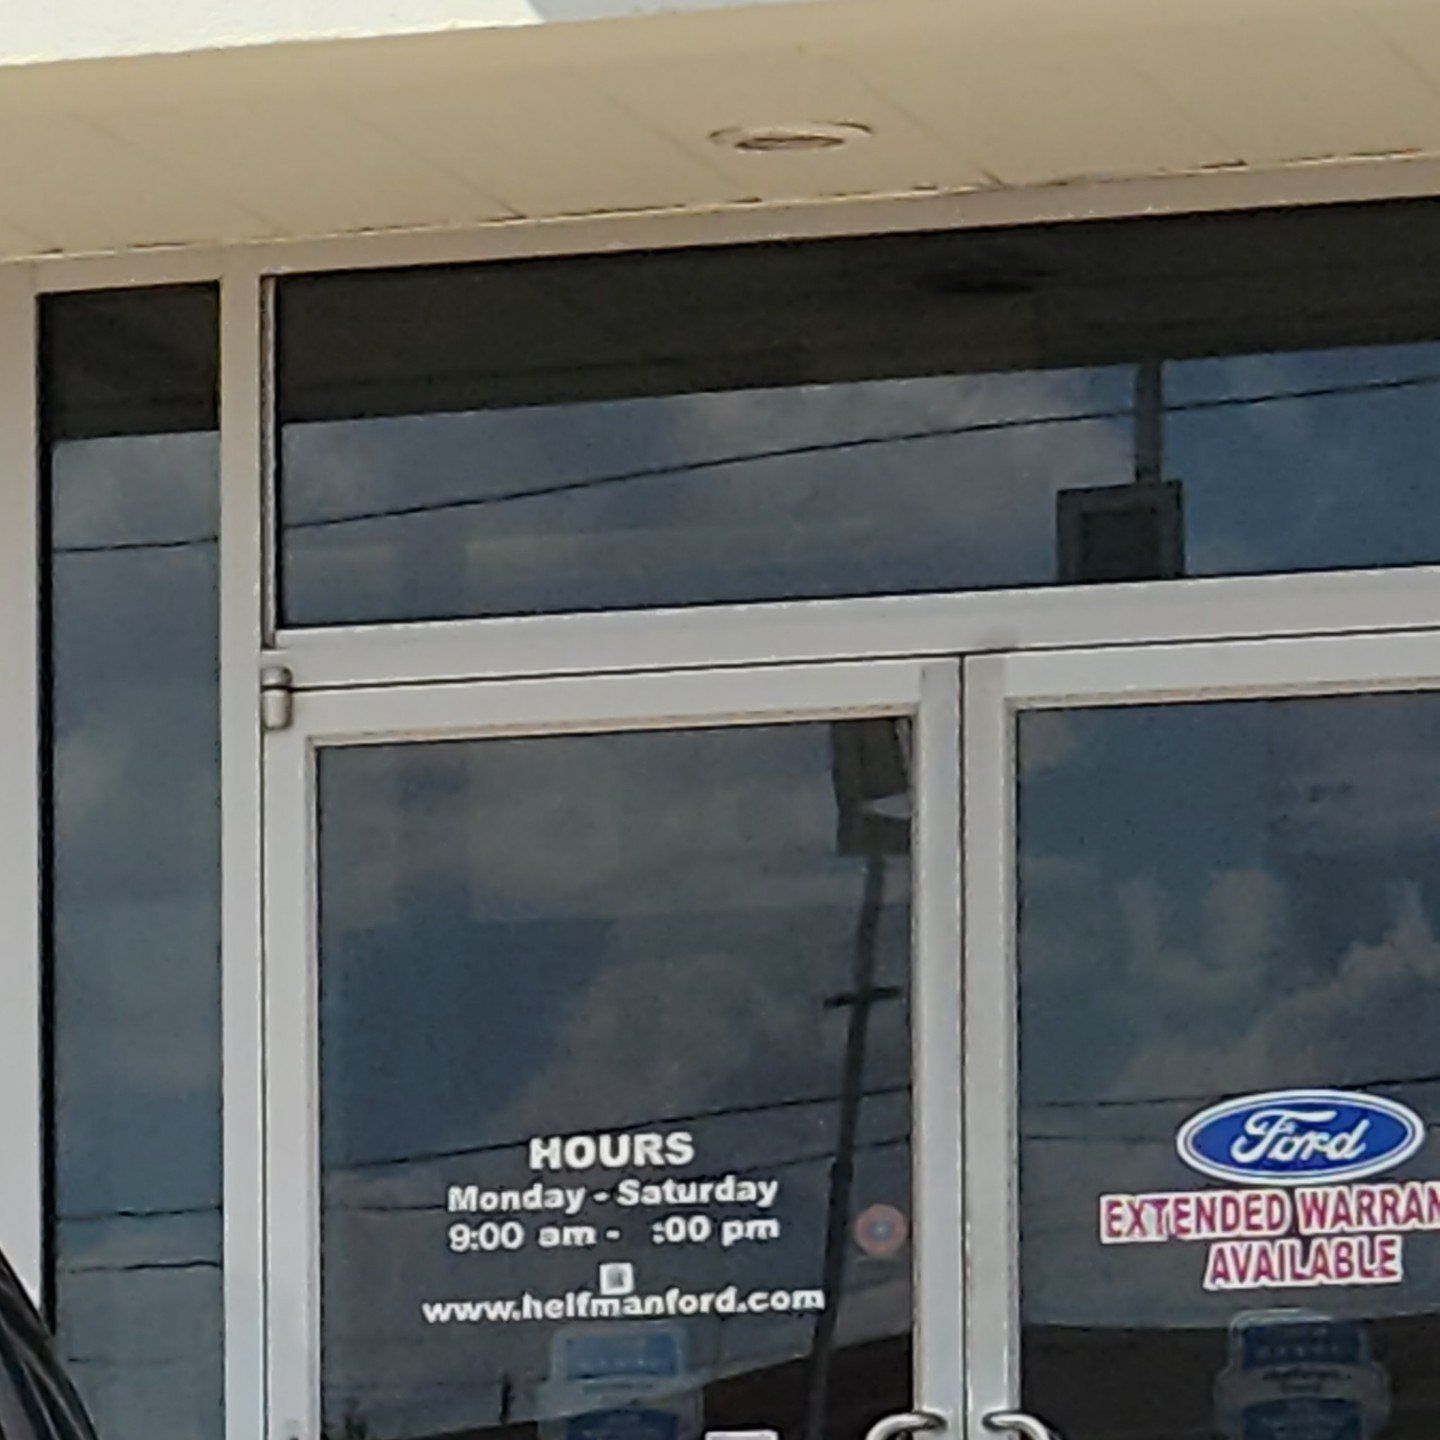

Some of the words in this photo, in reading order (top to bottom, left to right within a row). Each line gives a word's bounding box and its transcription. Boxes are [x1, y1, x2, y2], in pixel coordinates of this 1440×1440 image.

[529, 1132, 695, 1170] HOURS
[1230, 1109, 1370, 1164] Ford
[447, 1184, 586, 1214] Monday
[616, 1175, 779, 1208] Saturday
[448, 1222, 525, 1251] 9:00
[538, 1225, 597, 1248] am
[720, 1216, 780, 1246] pm
[1105, 1193, 1284, 1238] EXTENDED
[1210, 1238, 1397, 1284] AVAILABLE
[421, 1286, 826, 1324] www.helfmanford.com
